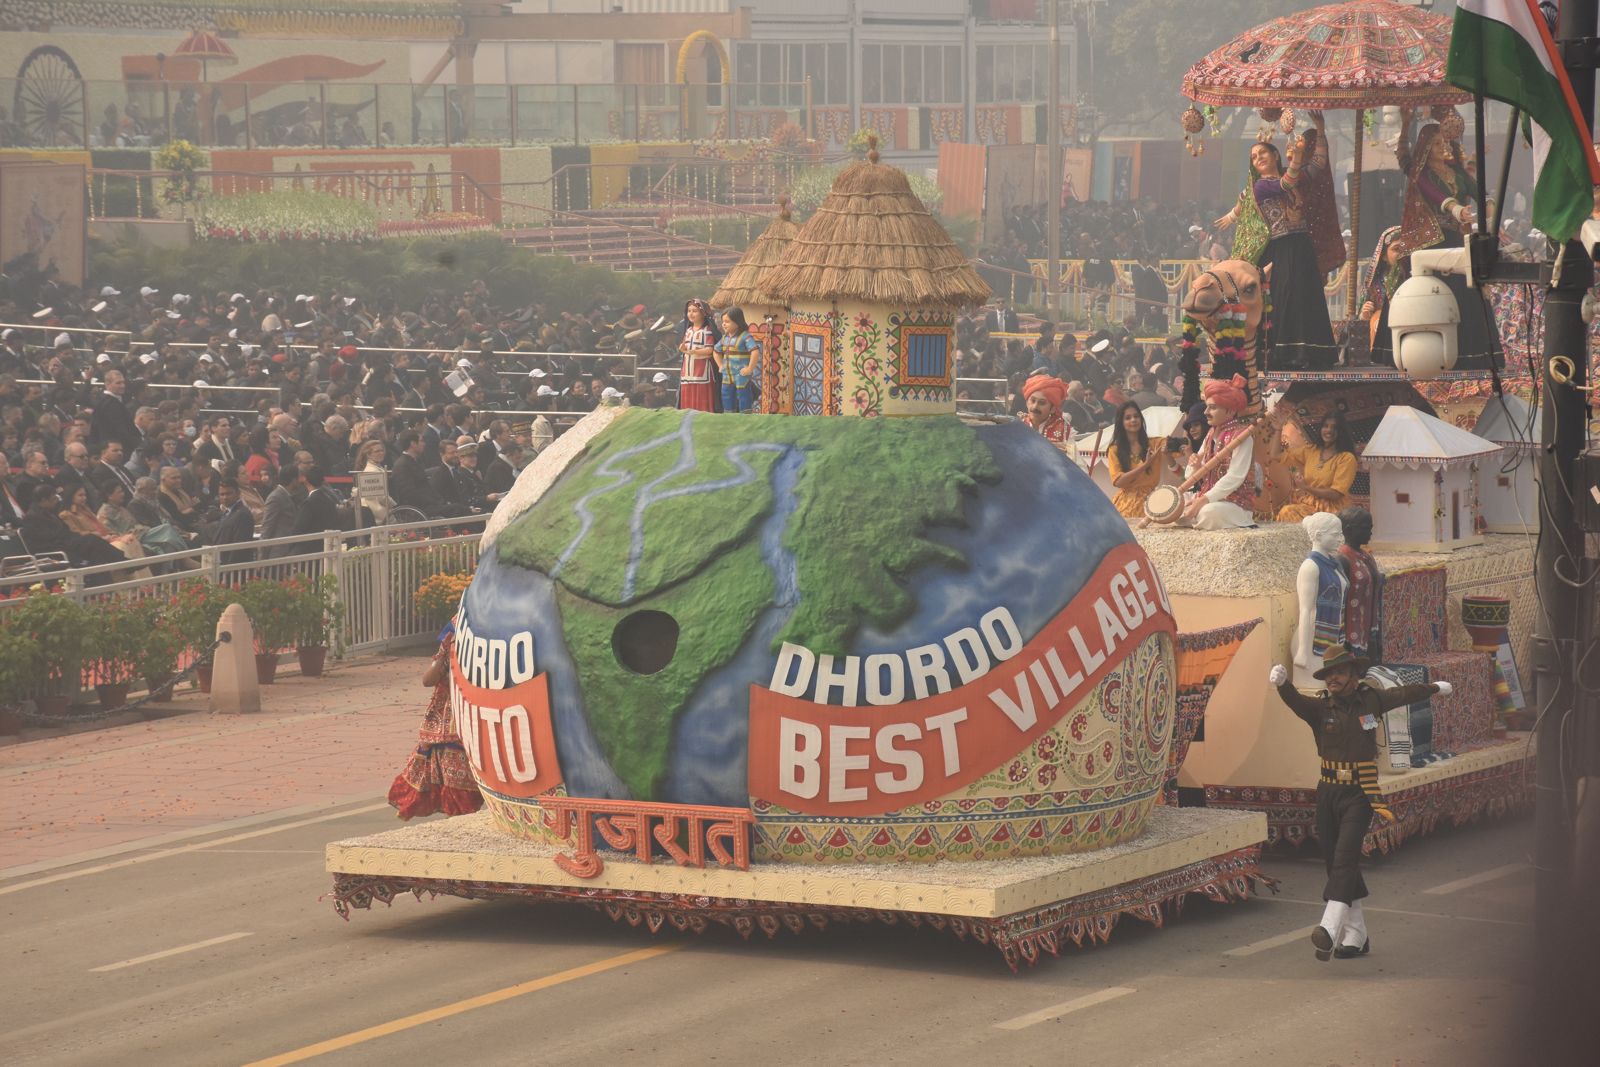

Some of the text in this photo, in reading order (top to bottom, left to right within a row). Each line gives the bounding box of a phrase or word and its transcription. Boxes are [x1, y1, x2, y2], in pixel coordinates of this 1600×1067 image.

[455, 587, 534, 690] HORDO
[769, 606, 1023, 706] DHORDO
[779, 707, 968, 803] BEST
[988, 560, 1157, 732] VILLAGE
[540, 795, 757, 879] गुजरात
